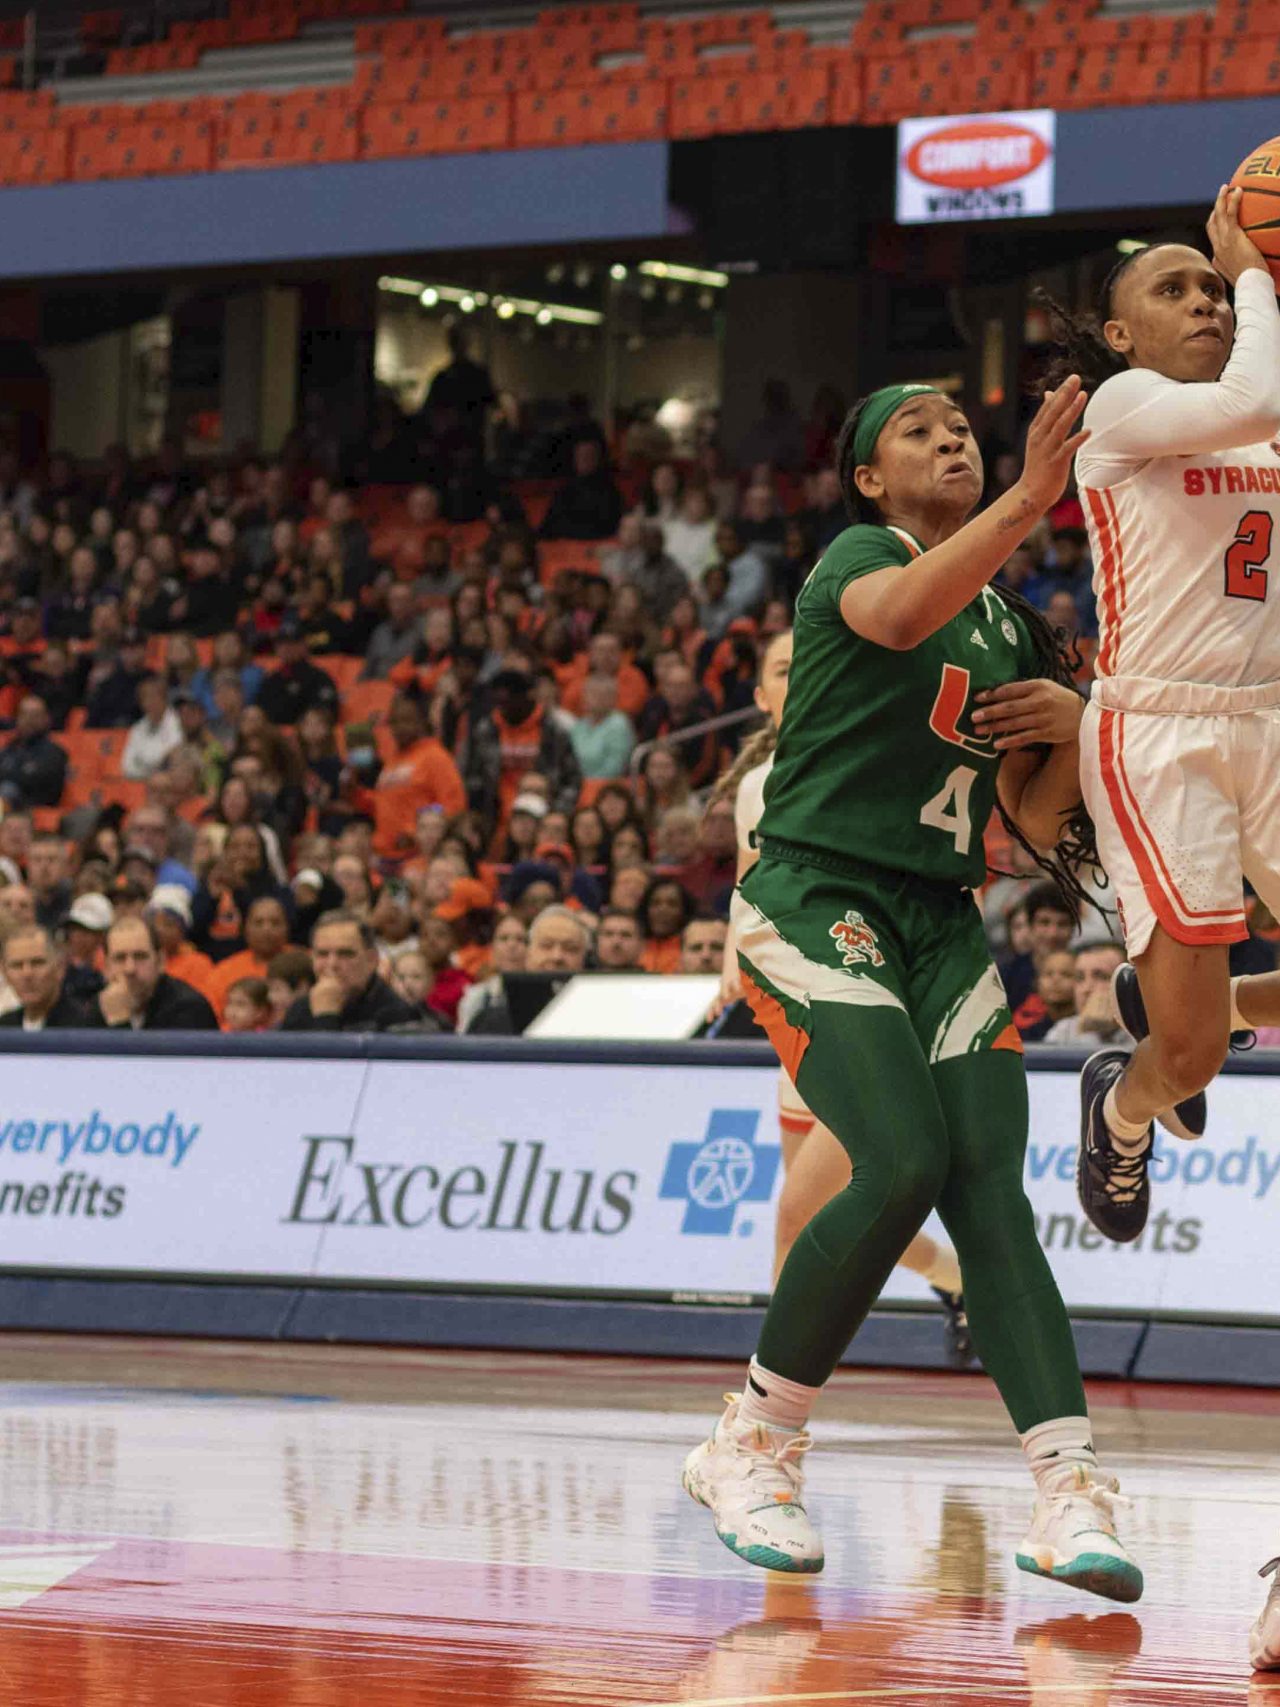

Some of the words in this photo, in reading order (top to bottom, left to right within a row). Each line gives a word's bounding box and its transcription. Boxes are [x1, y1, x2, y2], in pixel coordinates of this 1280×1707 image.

[918, 135, 1031, 174] COMFORT
[1224, 510, 1273, 602] 2
[920, 764, 978, 855] 4
[281, 1135, 637, 1236] Excellus
